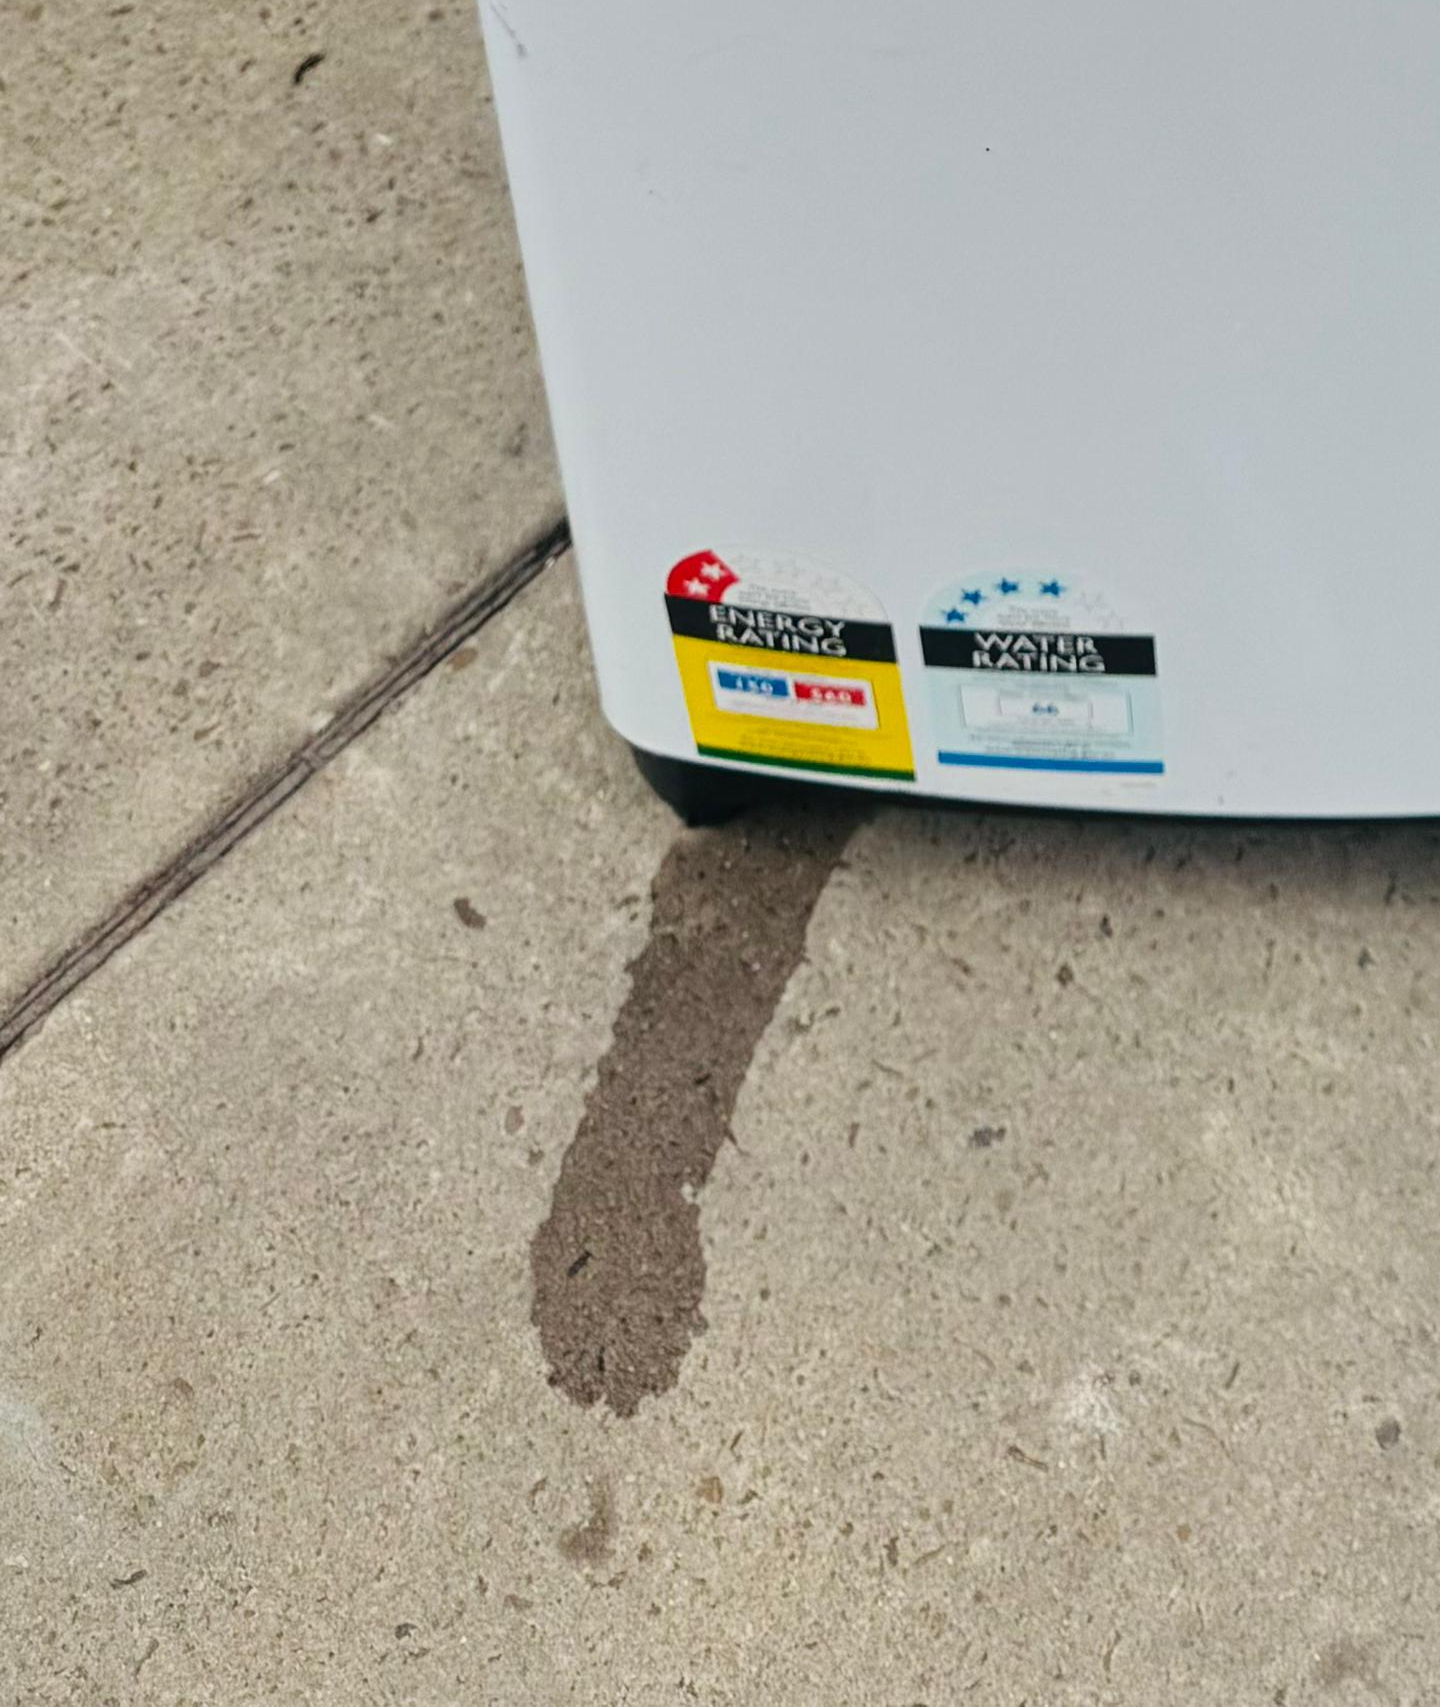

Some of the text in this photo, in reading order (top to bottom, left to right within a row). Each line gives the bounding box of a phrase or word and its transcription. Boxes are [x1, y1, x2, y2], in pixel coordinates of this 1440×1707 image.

[709, 604, 846, 638] ENERGY
[717, 623, 848, 657] RATING
[974, 631, 1098, 654] WATER
[972, 650, 1106, 673] RATING
